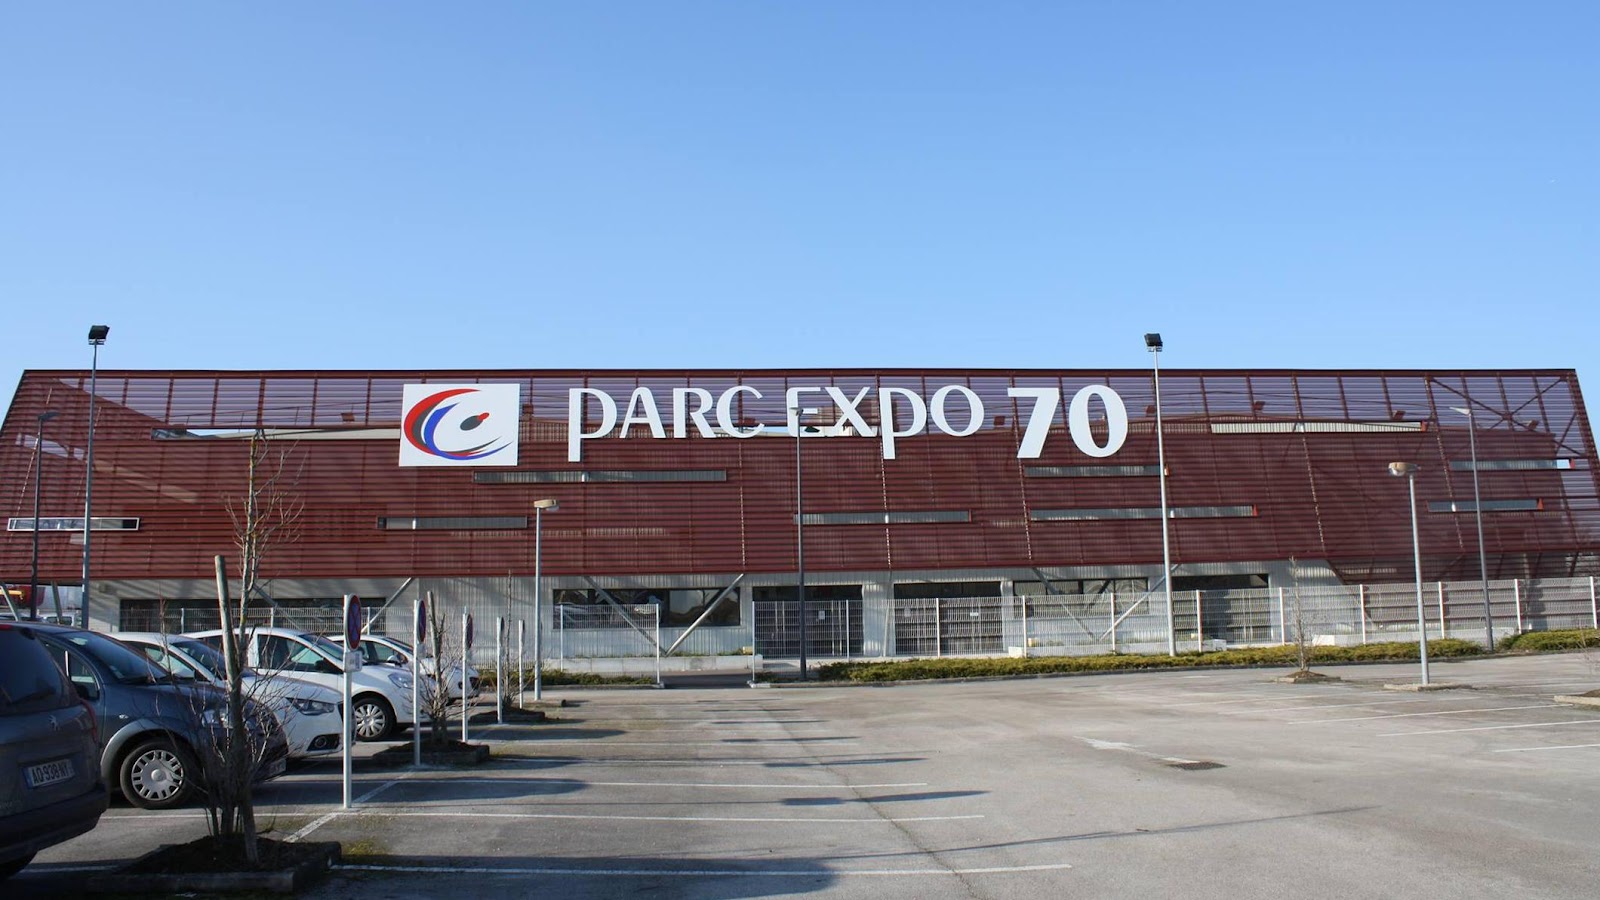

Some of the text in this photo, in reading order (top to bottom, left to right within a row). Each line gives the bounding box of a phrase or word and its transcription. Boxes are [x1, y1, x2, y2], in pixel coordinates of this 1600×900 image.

[568, 385, 1128, 462] PARC EXPO 70
